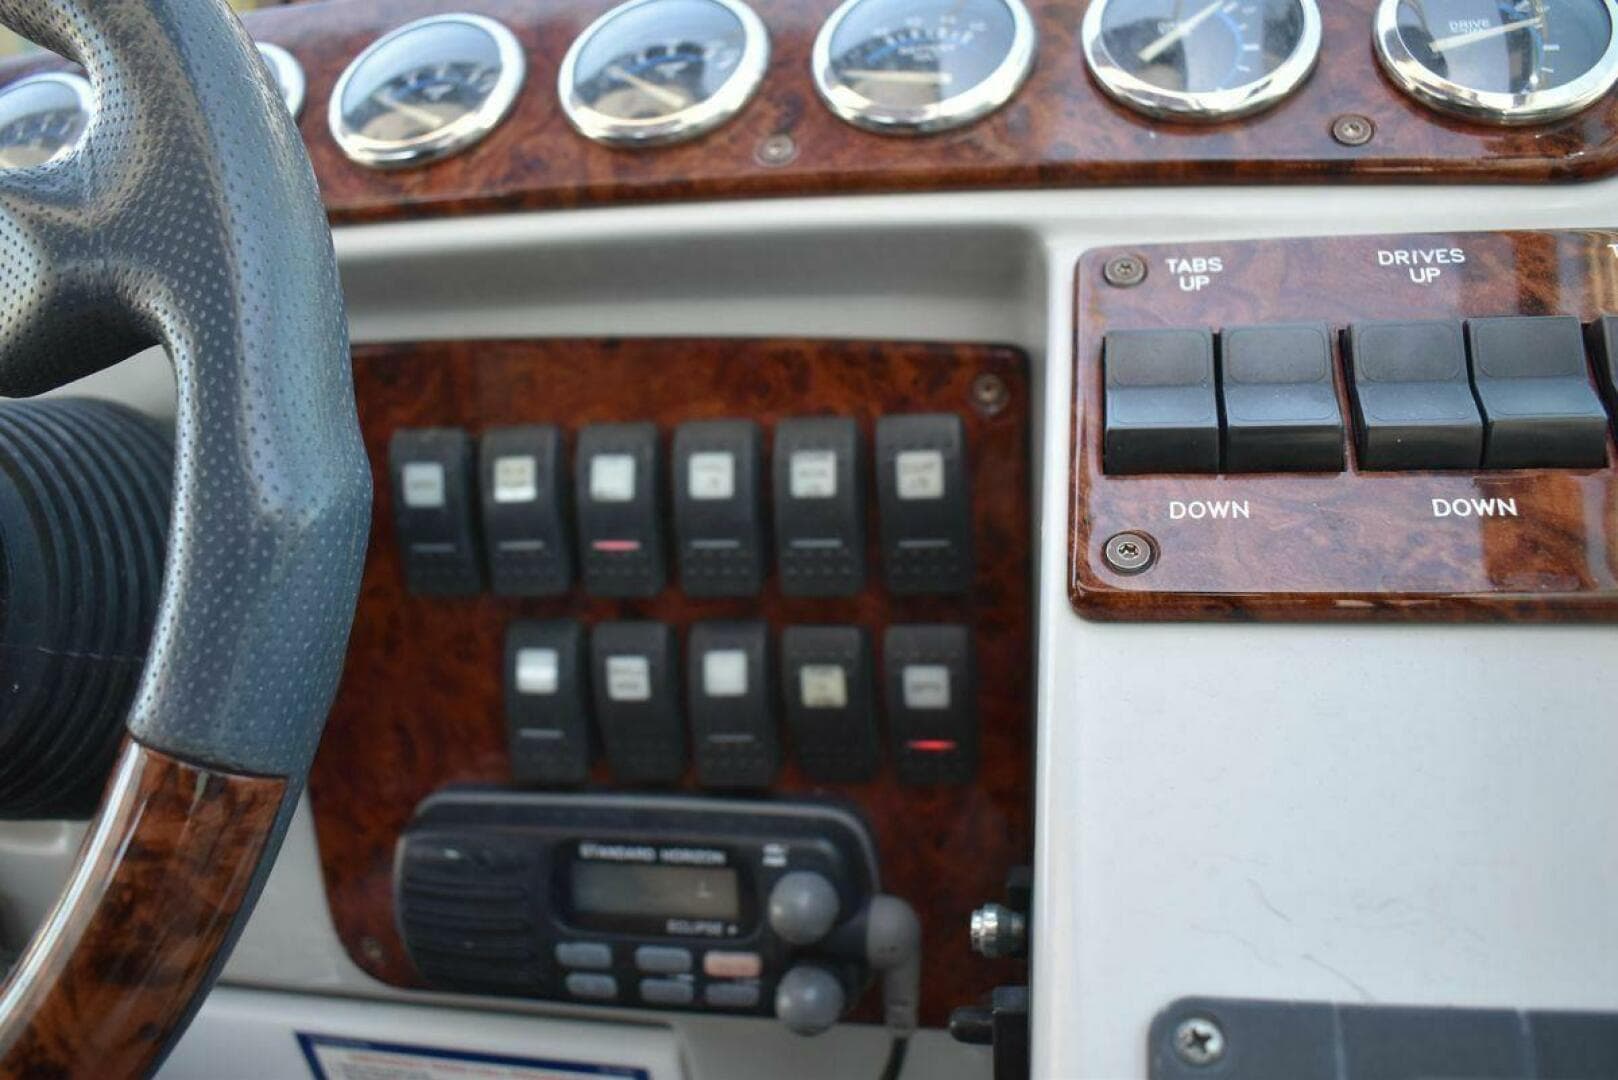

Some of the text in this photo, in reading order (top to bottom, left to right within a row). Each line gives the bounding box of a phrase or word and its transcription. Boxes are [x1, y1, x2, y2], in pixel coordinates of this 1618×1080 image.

[1165, 256, 1223, 274] TABS
[1378, 248, 1465, 265] DRIVES
[1180, 275, 1210, 291] UP
[1409, 267, 1440, 283] UP
[1169, 500, 1249, 519] DOWN
[1432, 498, 1518, 517] DOWN
